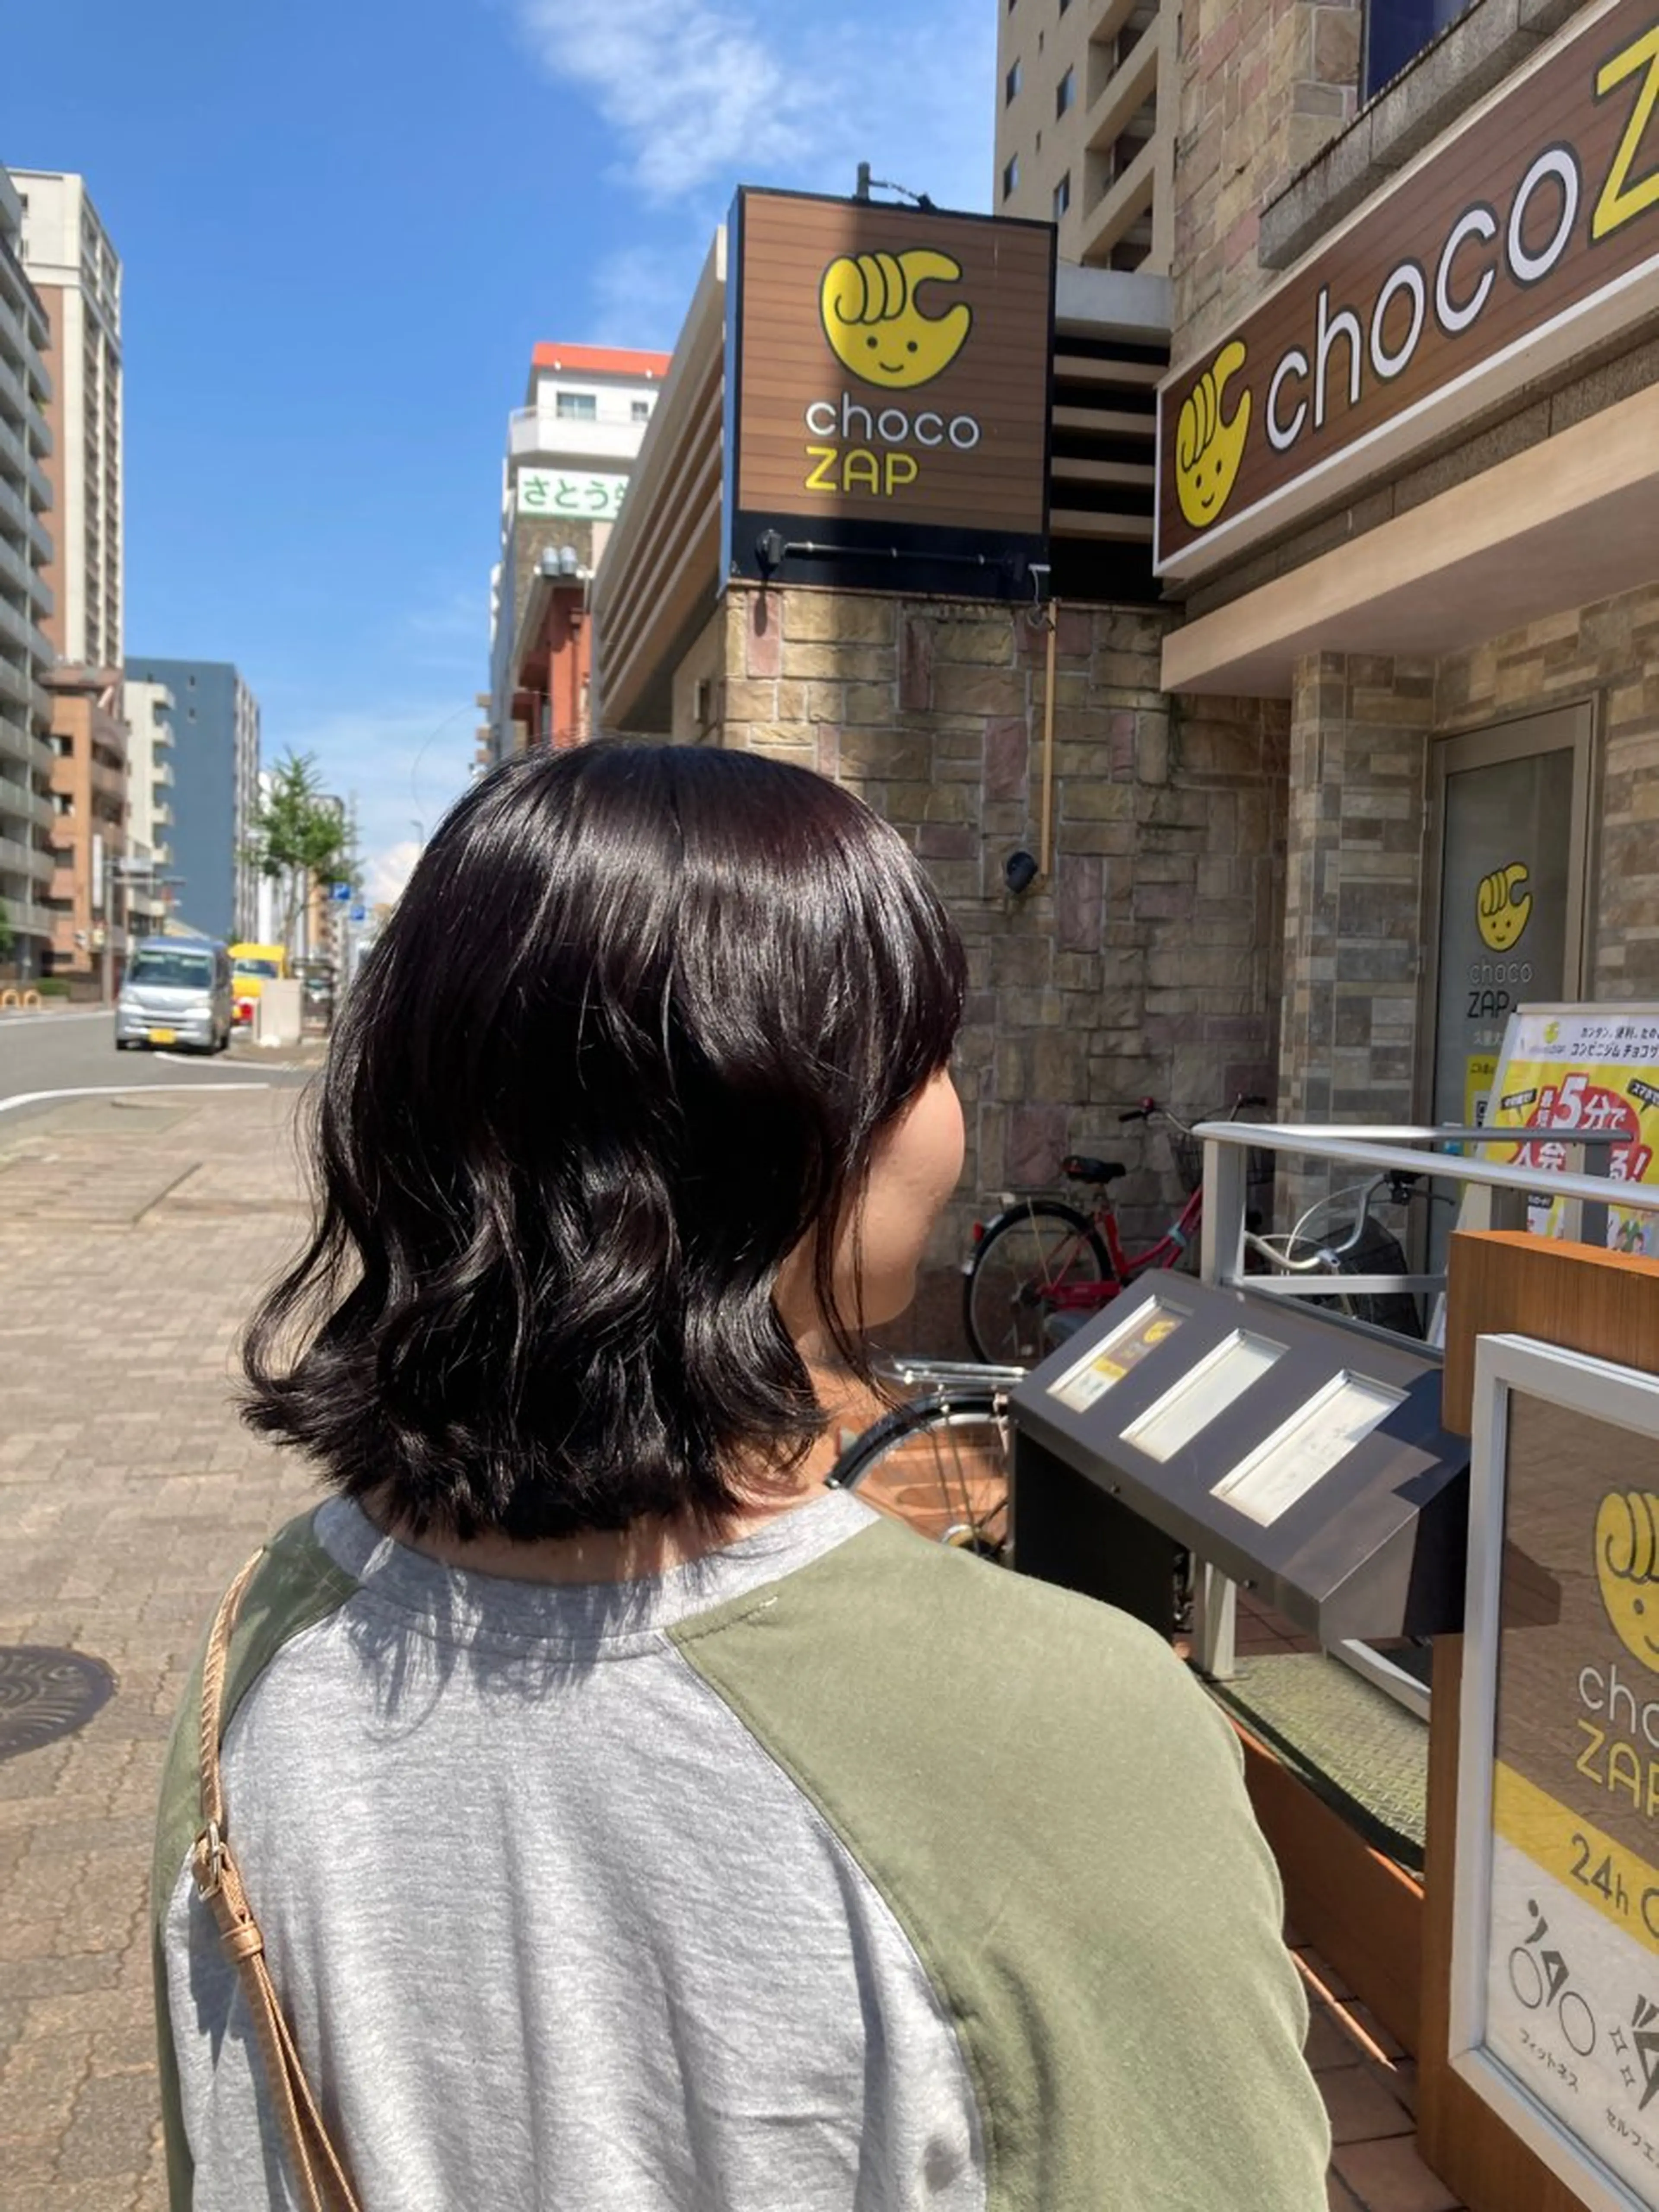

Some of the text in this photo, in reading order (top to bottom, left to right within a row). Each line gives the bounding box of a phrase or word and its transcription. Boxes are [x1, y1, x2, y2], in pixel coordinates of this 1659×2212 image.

[806, 392, 979, 448] choco
[806, 446, 918, 495] ZAP
[1470, 959, 1533, 983] choco
[1468, 991, 1510, 1018] ZAP
[1571, 1834, 1628, 1916] 24h
[1519, 2027, 1578, 2093] フィットネス
[1606, 2106, 1659, 2168] セルフエ
